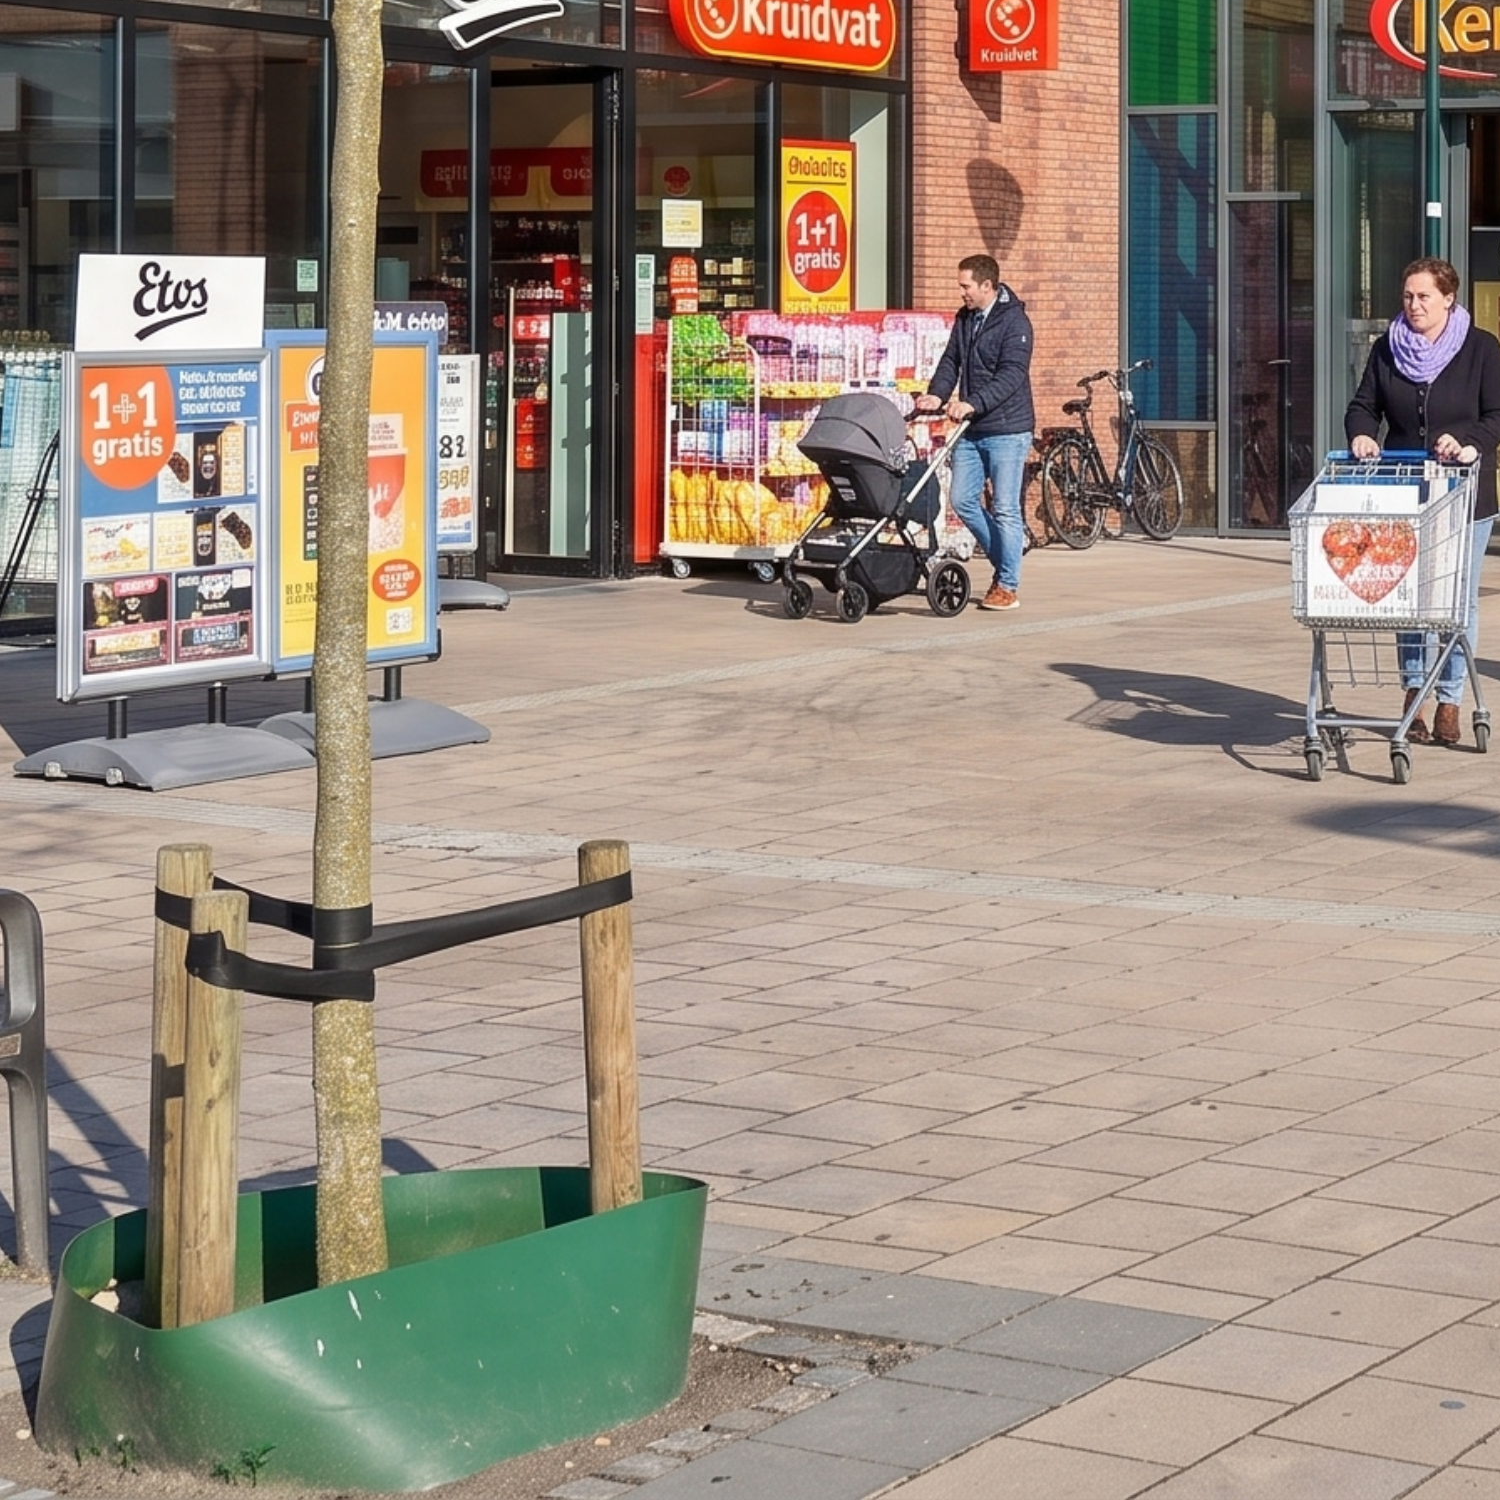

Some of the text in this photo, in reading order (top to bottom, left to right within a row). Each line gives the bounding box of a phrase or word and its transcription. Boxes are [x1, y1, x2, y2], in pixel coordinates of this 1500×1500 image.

[795, 212, 838, 247] 1+1
[133, 261, 208, 317] Etos
[89, 380, 157, 430] 1+1
[92, 430, 164, 467] gratis
